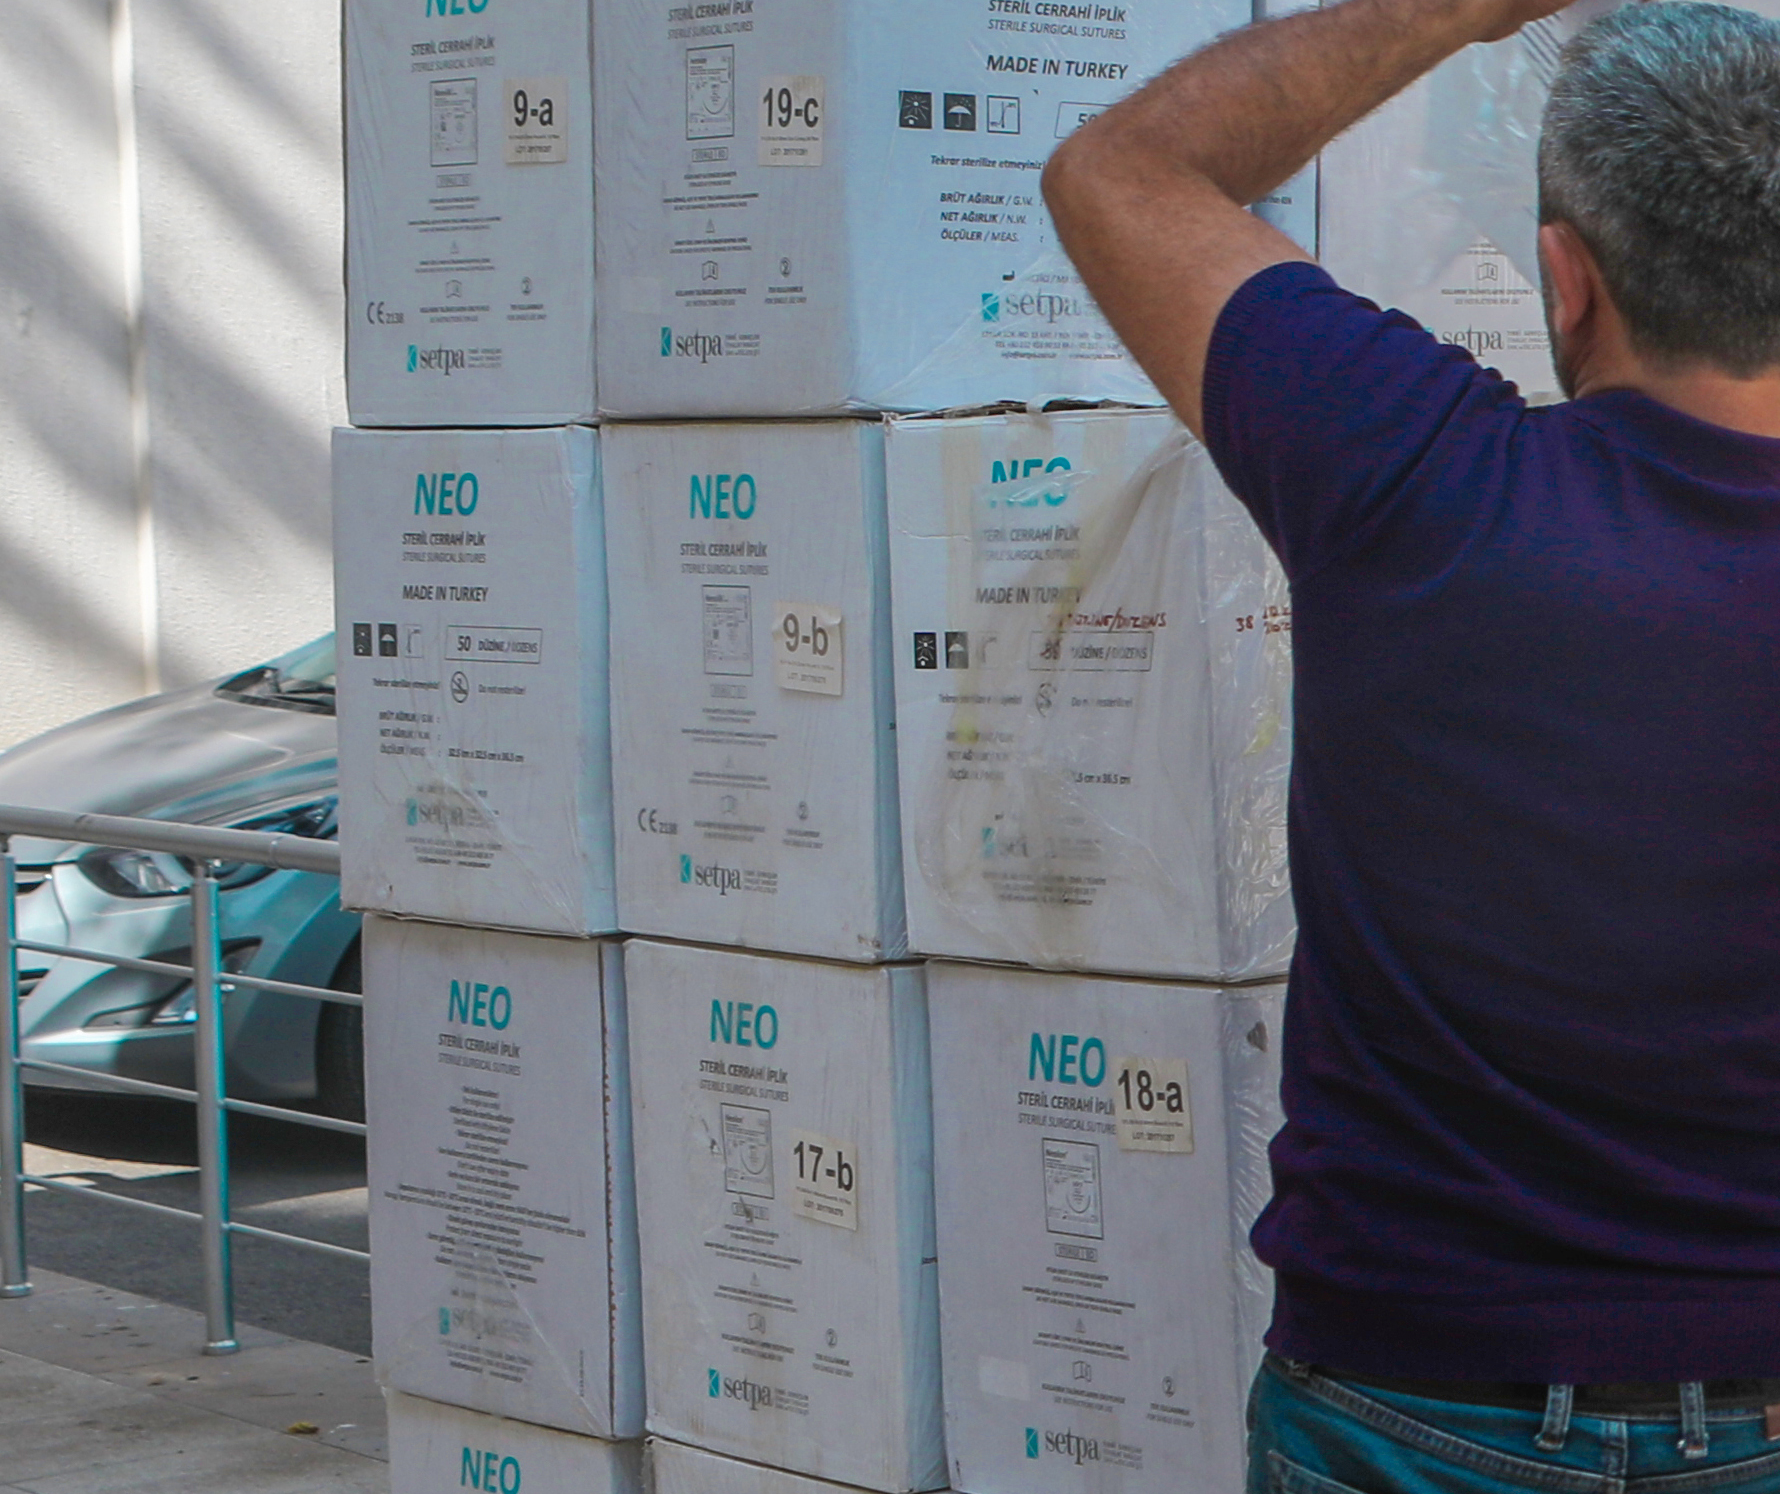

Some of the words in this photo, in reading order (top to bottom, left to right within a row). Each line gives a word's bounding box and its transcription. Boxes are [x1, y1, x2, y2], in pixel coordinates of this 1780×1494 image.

[987, 19, 1027, 33] STERILE
[1030, 22, 1079, 37] SURGICAL
[1081, 26, 1127, 40] SUTURES
[1035, 2, 1091, 20] CERRAHİ
[1093, 4, 1127, 23] İPLİK
[986, 55, 1038, 74] MADE
[1042, 58, 1060, 75] IN
[1065, 60, 1129, 80] TURKEY
[513, 89, 554, 127] 9-a
[763, 87, 820, 128] 19-c
[676, 328, 723, 364] setpa
[1441, 324, 1505, 357] setpa
[420, 345, 465, 376] setpa
[414, 472, 479, 516] NEO
[690, 473, 757, 520] NEO
[403, 585, 434, 600] MADE
[435, 586, 447, 601] IN
[449, 586, 489, 602] TURKEY
[976, 587, 1013, 604] MADE
[1016, 587, 1030, 604] IN
[457, 635, 472, 651] 50
[783, 613, 829, 656] 9-b
[694, 863, 742, 895] setpa
[448, 979, 512, 1031] NEO
[710, 998, 779, 1050] NEO
[1028, 1032, 1107, 1088] NEO
[1018, 1090, 1049, 1108] STERİL
[1051, 1095, 1093, 1113] CERRAHİ
[1118, 1068, 1185, 1114] 18-a
[793, 1140, 854, 1192] 17-b
[723, 1373, 772, 1411] setpa
[1044, 1426, 1100, 1466] setpa
